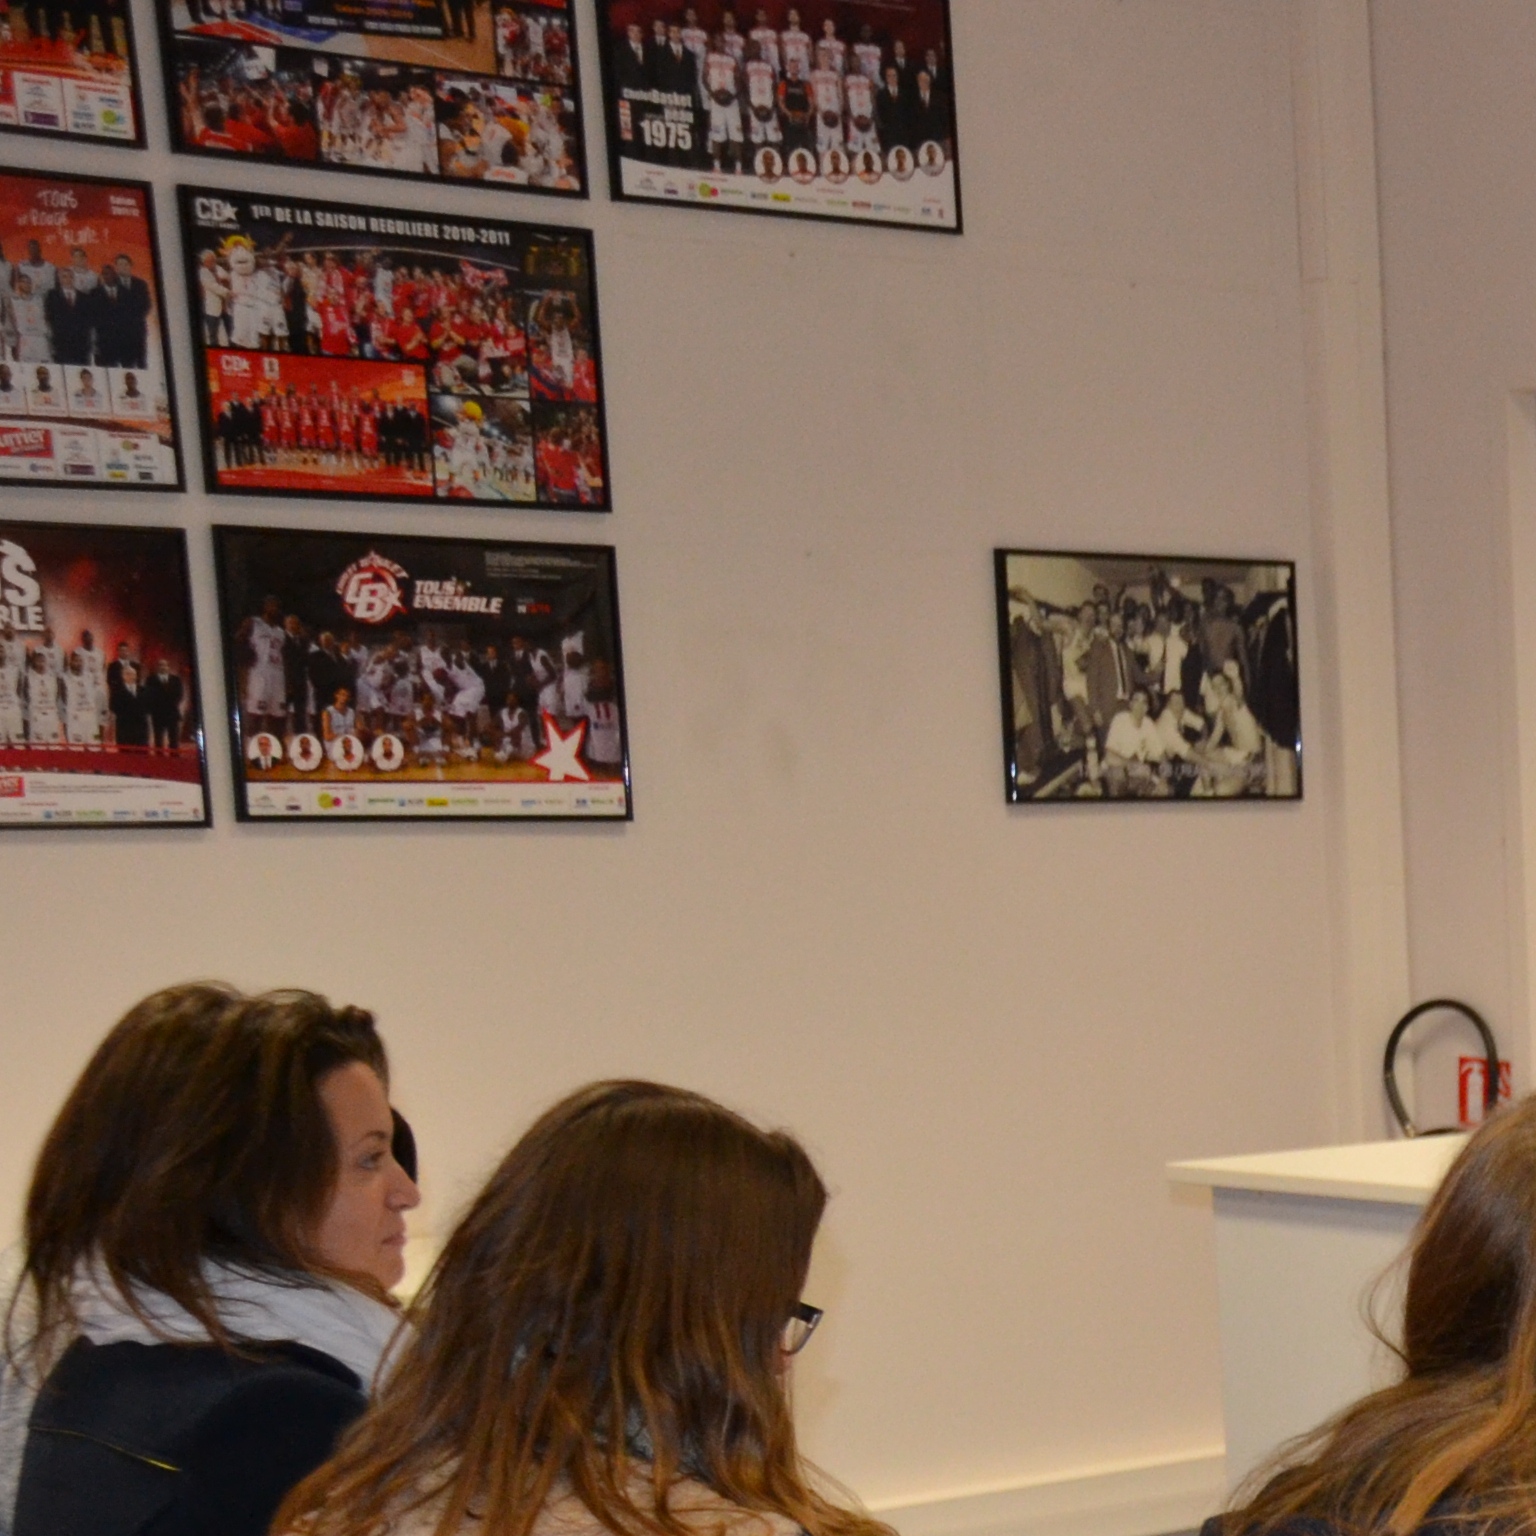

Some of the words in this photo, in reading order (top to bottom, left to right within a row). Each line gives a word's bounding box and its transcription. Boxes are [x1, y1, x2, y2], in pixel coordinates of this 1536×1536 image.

[639, 119, 693, 151] 1975
[274, 207, 294, 223] DE
[294, 210, 313, 226] LA
[315, 212, 368, 231] SAISON
[369, 217, 440, 239] REGULIERE
[443, 225, 512, 246] 2010-2011
[414, 579, 457, 596] TOUS
[412, 595, 504, 614] ENSEMBLE
